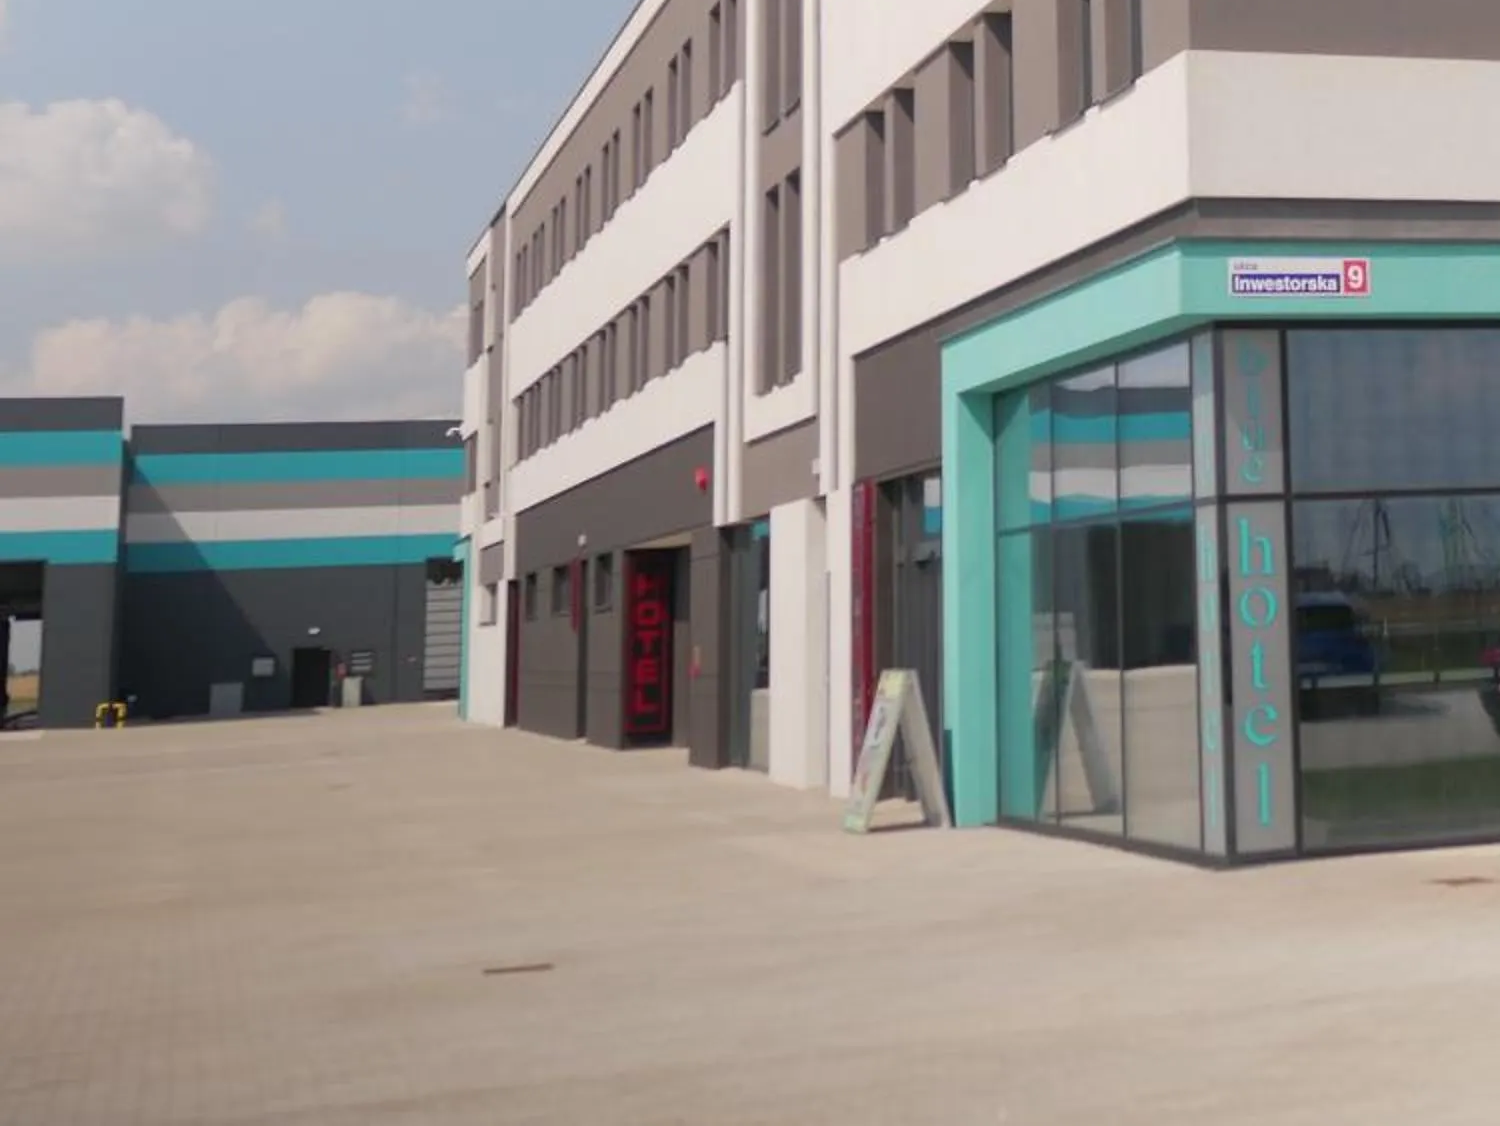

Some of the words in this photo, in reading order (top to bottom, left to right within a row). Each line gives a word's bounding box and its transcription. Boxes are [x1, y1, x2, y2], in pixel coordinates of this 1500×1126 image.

[1234, 275, 1337, 291] Inwestorska
[1347, 265, 1364, 289] 9
[1237, 517, 1278, 827] hotel
